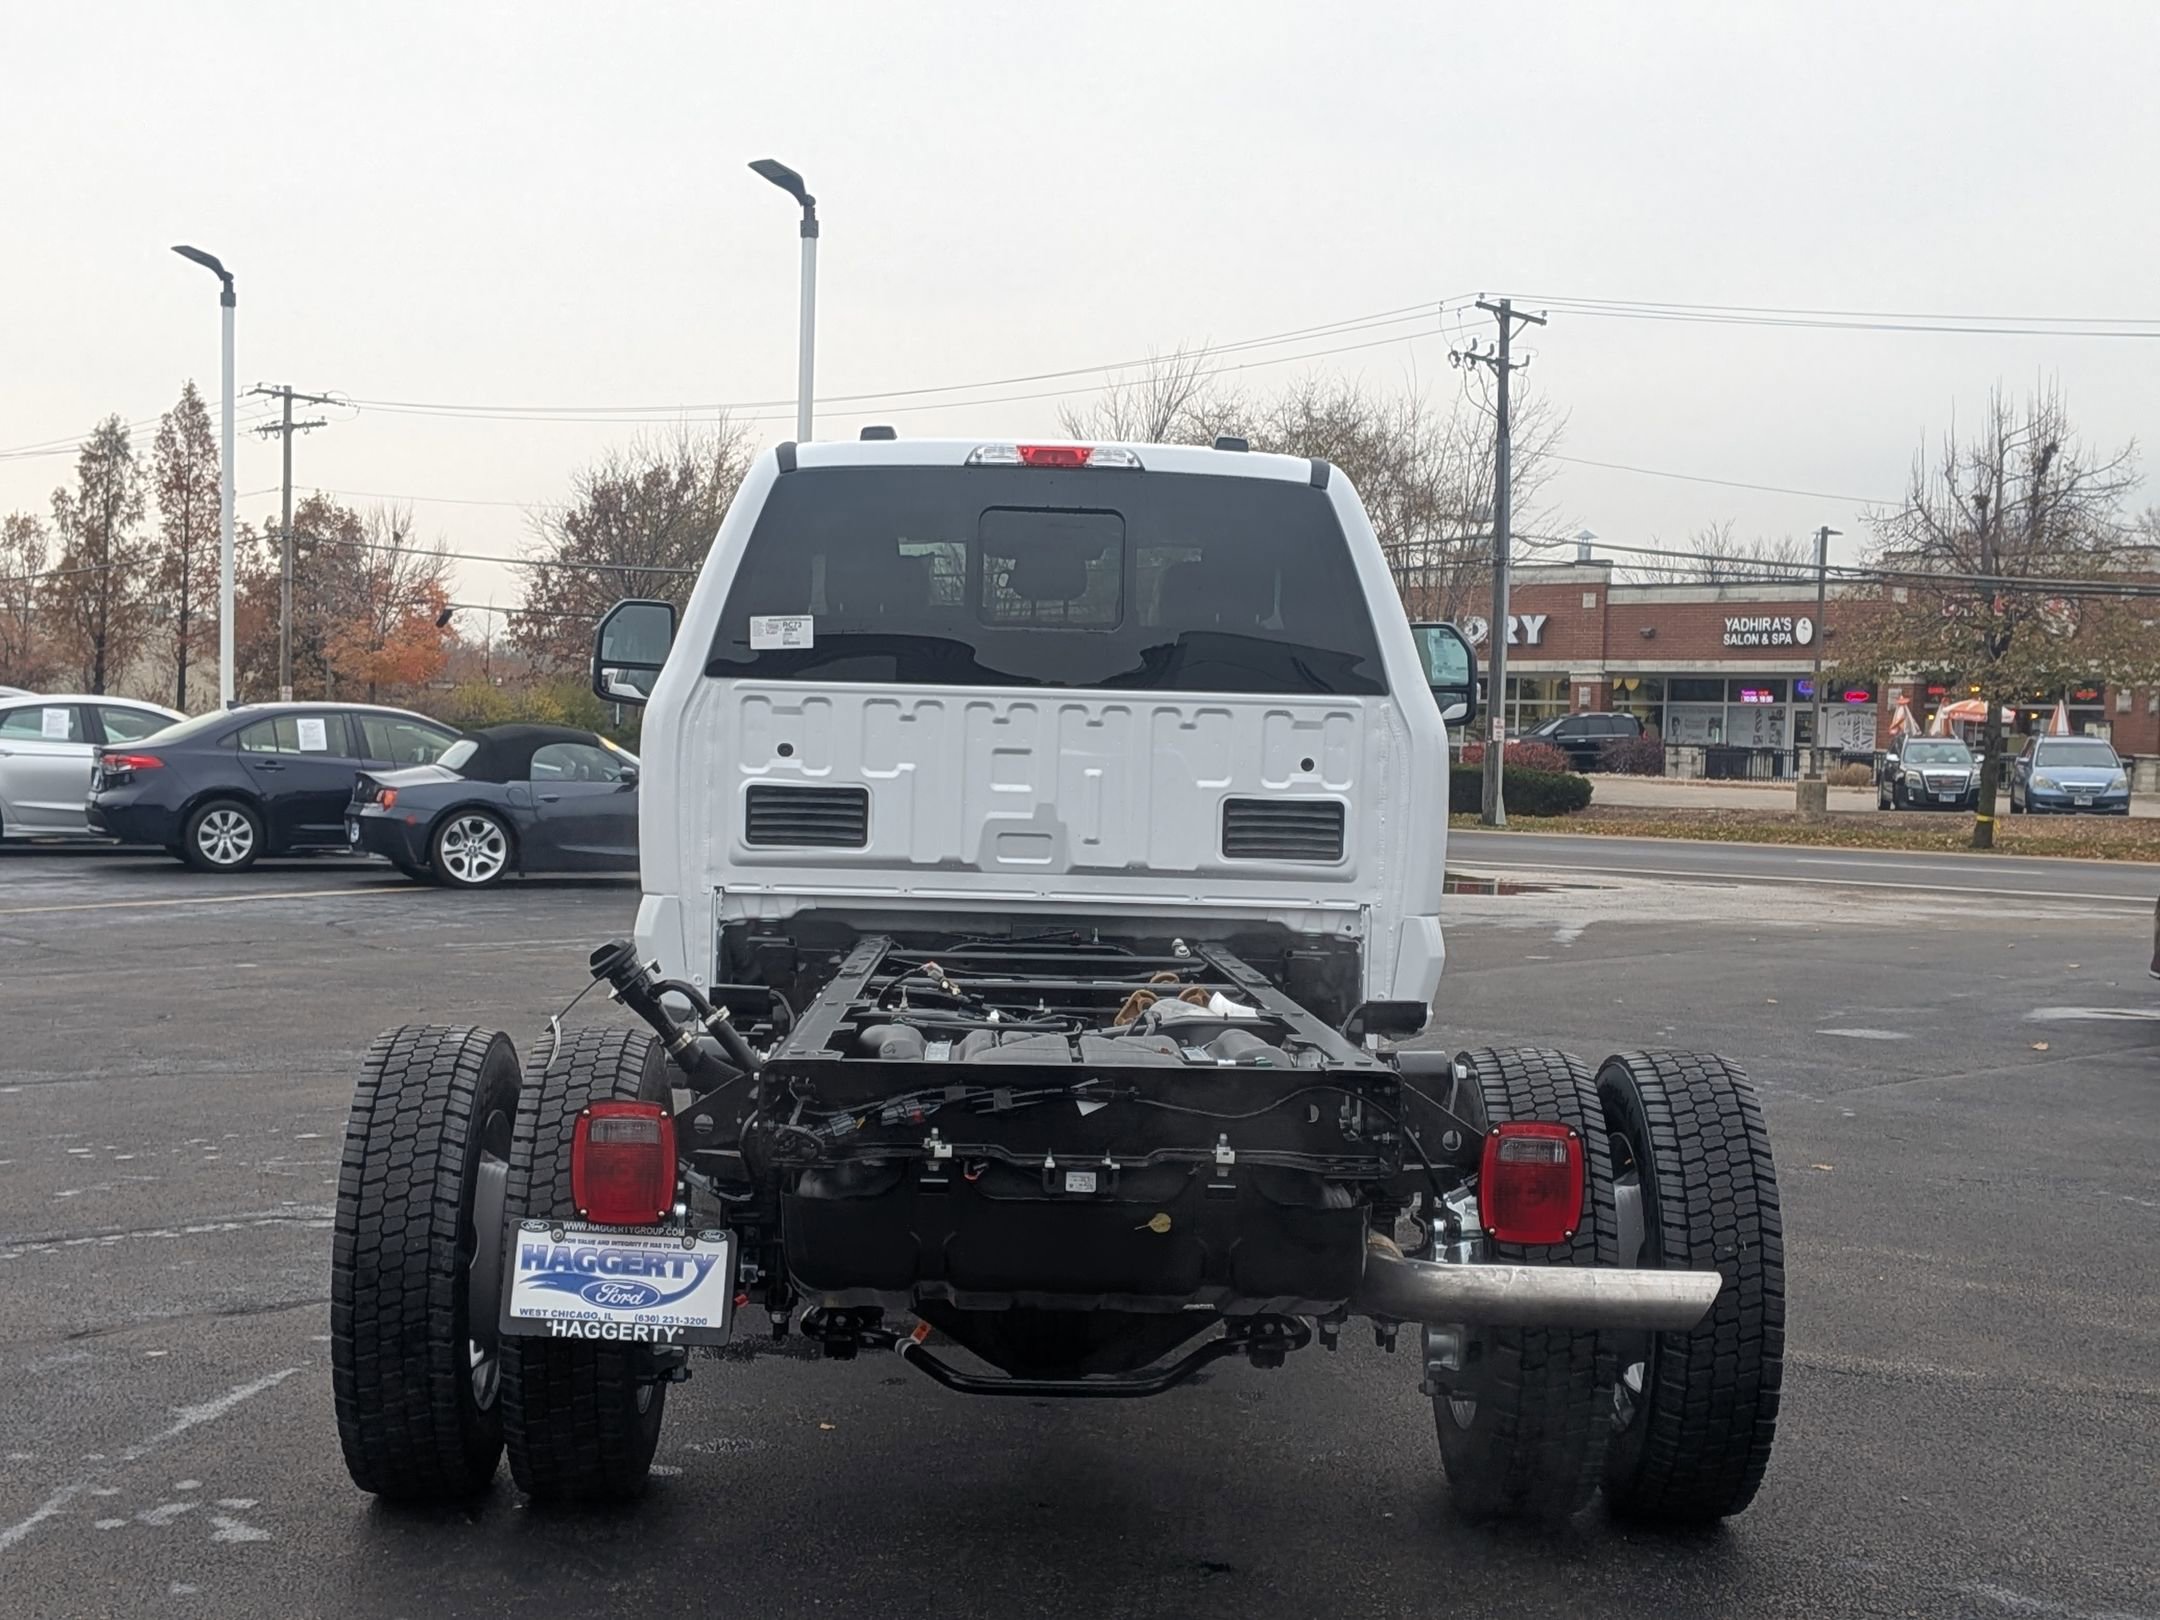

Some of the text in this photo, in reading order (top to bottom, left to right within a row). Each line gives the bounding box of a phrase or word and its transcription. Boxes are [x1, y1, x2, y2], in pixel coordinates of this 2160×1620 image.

[1724, 617, 1792, 632] YADHIRA'S
[1723, 633, 1792, 645] SALON & SPA
[563, 1220, 685, 1237] WWW.HAGGERTYGROUP.COM
[611, 1240, 641, 1248] INTEGRITY
[521, 1244, 719, 1279] HAGGERTY
[596, 1283, 646, 1305] Ford
[520, 1308, 707, 1326] WEST CHICAGO, IL (630) 231-3200
[552, 1319, 678, 1343] HAGGERTY
